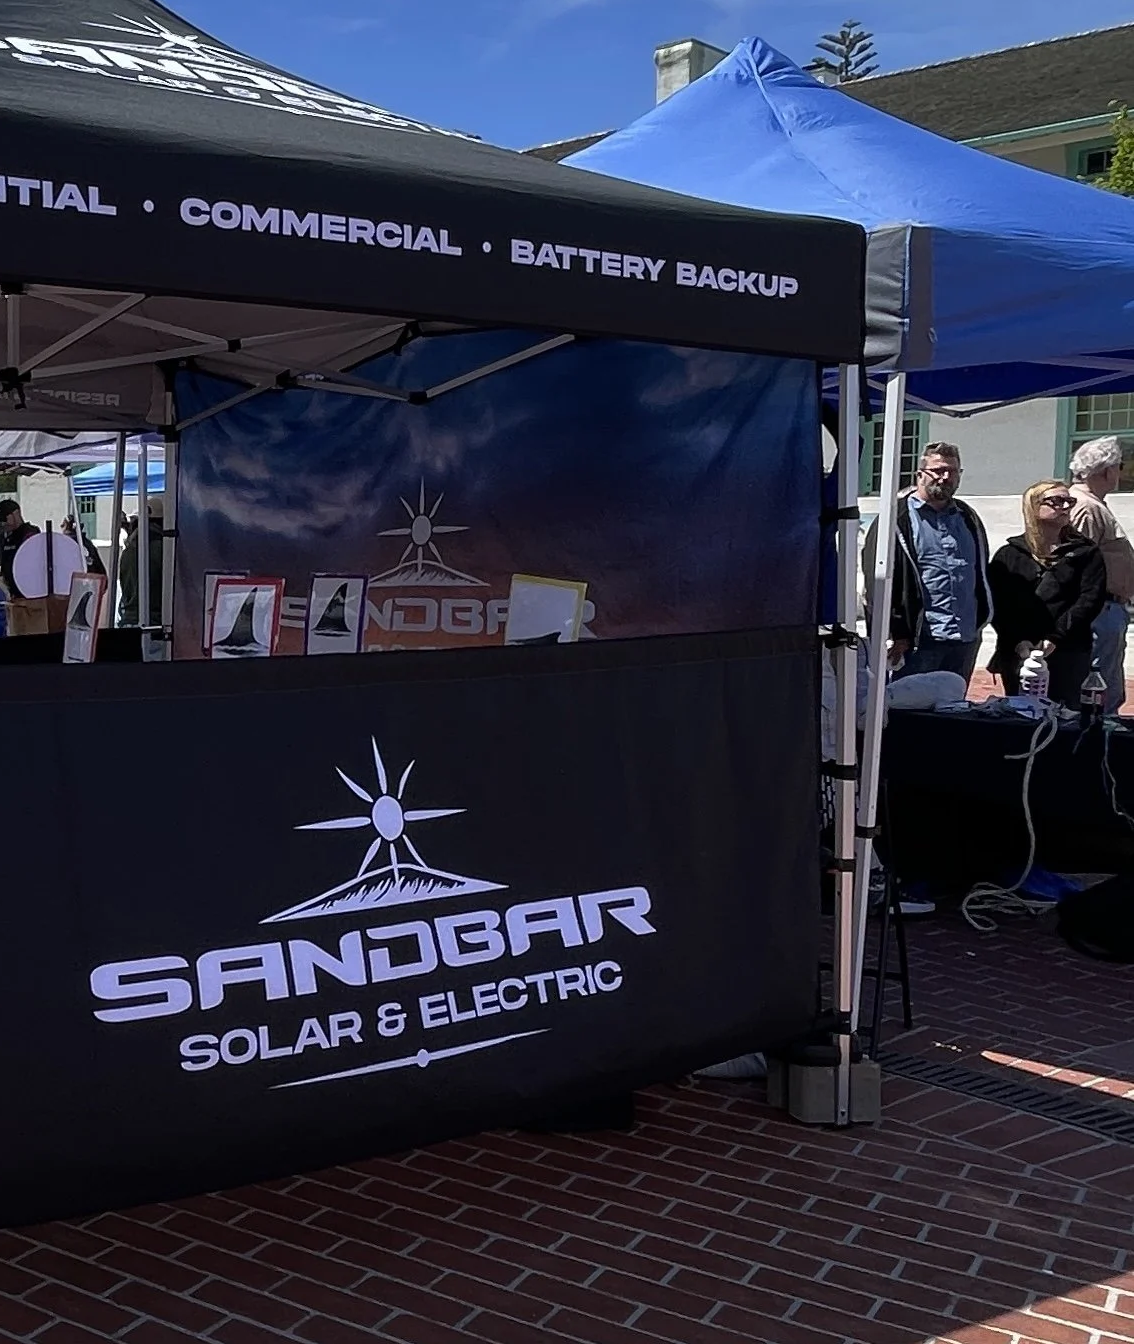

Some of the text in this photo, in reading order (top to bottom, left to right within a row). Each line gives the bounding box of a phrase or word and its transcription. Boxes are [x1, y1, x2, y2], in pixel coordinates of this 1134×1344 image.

[179, 197, 462, 256] COMMERCIAL
[511, 239, 666, 282] BATTERY
[676, 261, 799, 299] BACKUP
[90, 886, 657, 1023] SANDBAR
[179, 959, 625, 1072] SOLAR & ELECTRIC
